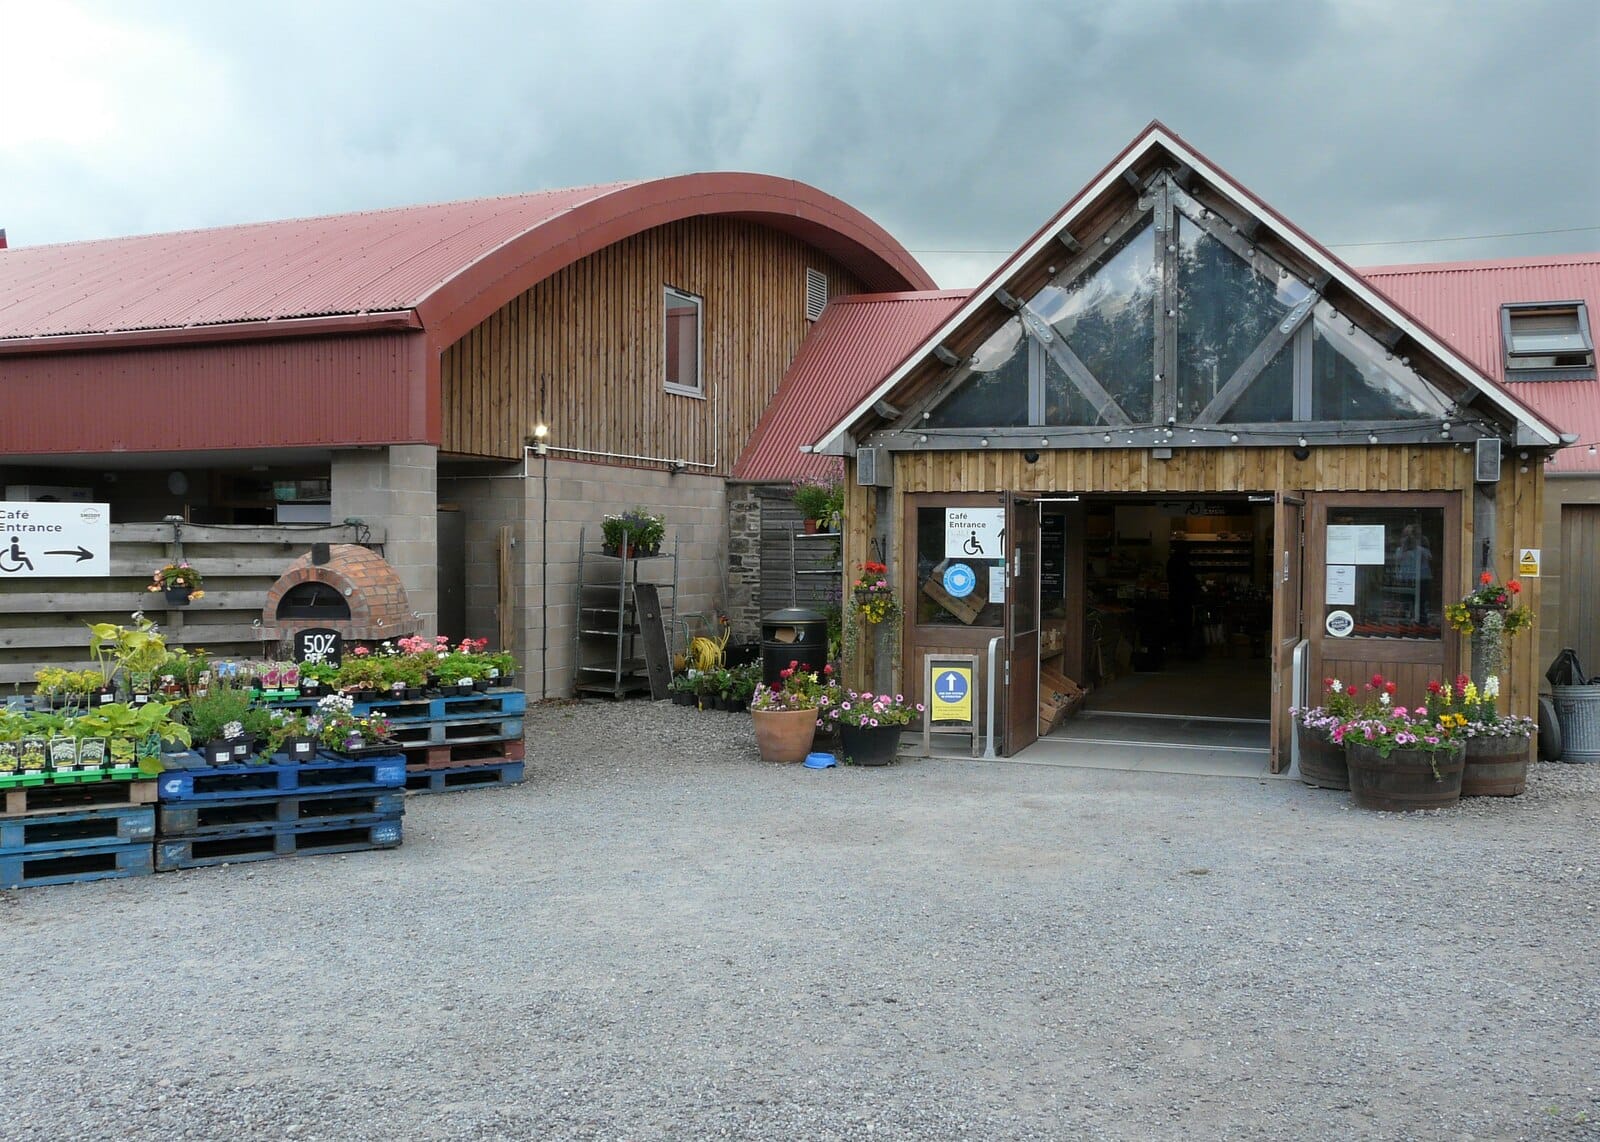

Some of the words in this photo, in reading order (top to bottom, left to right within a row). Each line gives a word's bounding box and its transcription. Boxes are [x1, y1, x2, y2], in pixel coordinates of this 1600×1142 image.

[949, 512, 968, 520] Café
[0, 522, 62, 532] Entrance
[949, 521, 987, 529] Entrance
[303, 634, 337, 654] 50%
